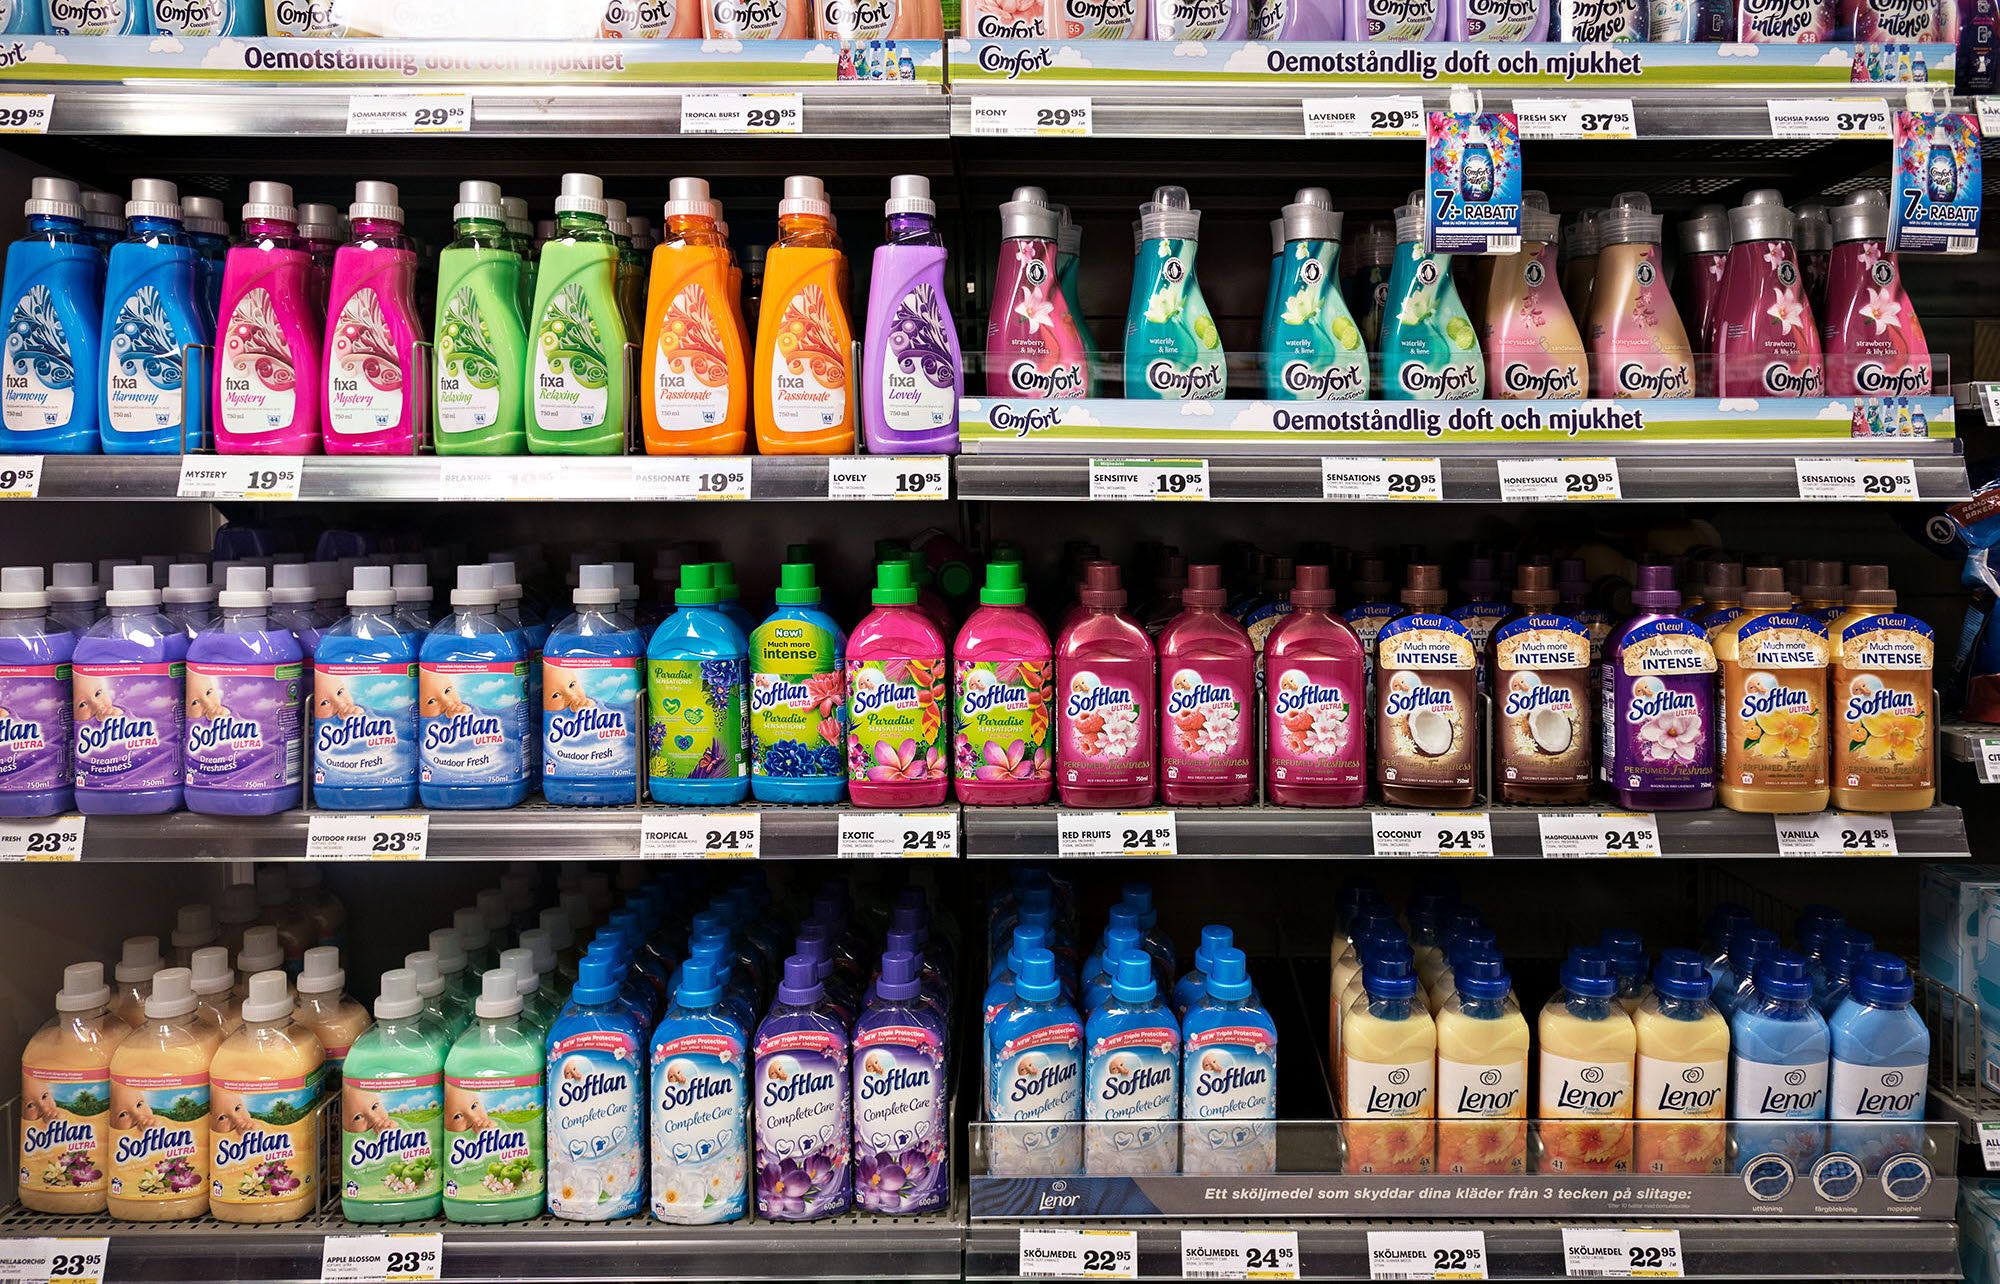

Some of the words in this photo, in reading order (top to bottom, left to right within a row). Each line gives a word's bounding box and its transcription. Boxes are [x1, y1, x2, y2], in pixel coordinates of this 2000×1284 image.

[978, 14, 1045, 39] Comfort
[1468, 21, 1481, 30] 55
[1752, 12, 1812, 37] intense
[1801, 34, 1816, 43] 38
[244, 47, 418, 76] Oemotståndlig
[979, 44, 1053, 79] Comfort
[1267, 49, 1437, 79] Oemotståndlig
[1444, 50, 1491, 74] doft
[1497, 51, 1539, 74] och
[1546, 50, 1642, 80] mjukhet
[975, 109, 1007, 117] PEONY
[1308, 112, 1356, 121] LAVENDER
[1519, 114, 1547, 122] FRESH
[1549, 114, 1567, 122] SKY
[1465, 206, 1518, 220] RABATT
[1930, 206, 1979, 221] RABATT
[1011, 339, 1045, 348] strawberry
[1149, 338, 1176, 347] waterlily
[1037, 346, 1050, 354] kiss
[113, 374, 138, 389] fixa
[225, 376, 250, 391] fixa
[659, 373, 686, 388] fixa
[889, 373, 916, 388] fixa
[1011, 362, 1083, 398] Comfort
[1504, 363, 1578, 397] Comfort
[1856, 363, 1929, 397] Comfort
[112, 391, 160, 405] Harmony
[225, 391, 267, 407] Mystery
[538, 388, 581, 405] Relaxing
[659, 387, 713, 404] Passionate
[888, 388, 922, 404] Lovely
[989, 402, 1062, 437] Comfort
[1273, 408, 1442, 436] Oemotståndlig
[1448, 408, 1493, 430] doft
[1501, 409, 1541, 430] och
[1549, 409, 1643, 436] mjukhet
[185, 471, 227, 479] MYSTERY
[635, 474, 691, 483] PASSIONATE
[833, 473, 867, 483] LOVELY
[1093, 473, 1139, 483] SENSITIVE
[1326, 473, 1381, 483] SENSATIONS
[1503, 476, 1559, 485] HONEYSUCKLE
[1801, 475, 1857, 484] SENSATIONS
[1655, 619, 1685, 632] New!
[775, 629, 803, 638] New!
[767, 641, 788, 649] Much
[1650, 647, 1672, 656] Much
[1674, 647, 1694, 656] more
[763, 648, 817, 661] intense
[1642, 657, 1703, 671] INTENSE
[752, 683, 809, 713] Softlan
[788, 699, 811, 708] ULTRA
[852, 684, 917, 714] Softlan
[1066, 685, 1131, 716] Softlan
[1111, 701, 1134, 711] ULTRA
[1628, 693, 1696, 722] Softlan
[1675, 707, 1698, 717] ULTRA
[1846, 690, 1915, 722] Softlan
[866, 713, 915, 729] Paradise
[319, 717, 394, 752] Softlan
[867, 724, 914, 733] SENSATIONS
[78, 719, 154, 755] Softlan
[125, 737, 159, 749] ULTRA
[90, 756, 119, 766] Dream
[120, 752, 133, 765] of
[325, 758, 358, 769] Outdoor
[359, 756, 384, 767] Fresh
[90, 761, 133, 774] Freshness
[1624, 765, 1670, 775] PERFUMED
[1670, 762, 1714, 777] Freshness
[311, 834, 345, 842] OUTDOOR
[346, 834, 367, 842] FRESH
[645, 830, 689, 840] TROPICAL
[842, 830, 875, 840] EXOTIC
[1061, 830, 1079, 840] RED
[1080, 830, 1111, 840] FRUITS
[1376, 830, 1422, 839] COCONUT
[1780, 830, 1820, 840] VANILLA
[562, 1038, 576, 1048] NEW
[576, 1035, 591, 1045] Triple
[592, 1034, 623, 1043] Protection
[1196, 1066, 1267, 1098] Softlan
[559, 1073, 628, 1108] Softlan
[763, 1072, 834, 1107] Softlan
[1557, 1081, 1624, 1110] Lenor
[1367, 1085, 1427, 1113] Lenor
[1761, 1084, 1823, 1114] Lenor
[1199, 1099, 1246, 1120] Complete
[1246, 1095, 1267, 1108] Care
[561, 1106, 606, 1131] Complete
[606, 1101, 628, 1118] Care
[350, 1129, 428, 1167] Softlan
[402, 1147, 431, 1159] ULTRA
[1039, 1190, 1081, 1211] Lenor
[1204, 1188, 1227, 1200] Ett
[1231, 1187, 1313, 1203] sköljmedel
[1317, 1190, 1350, 1200] som
[1354, 1187, 1415, 1203] skyddar
[1419, 1187, 1451, 1200] dina
[1456, 1187, 1504, 1201] kläder
[1507, 1187, 1540, 1201] från
[1543, 1188, 1554, 1200] 3
[1557, 1187, 1609, 1201] tecken
[1612, 1187, 1632, 1204] på
[1636, 1187, 1692, 1204] slitage:
[1752, 1205, 1783, 1213] uttöjning
[1815, 1205, 1858, 1213] färgblekning
[1887, 1205, 1922, 1213] noppighet
[1185, 1246, 1240, 1257] SKÖLJMEDEL
[1568, 1246, 1623, 1257] SKÖLJMEDEL
[348, 1256, 381, 1264] BLOSSOM
